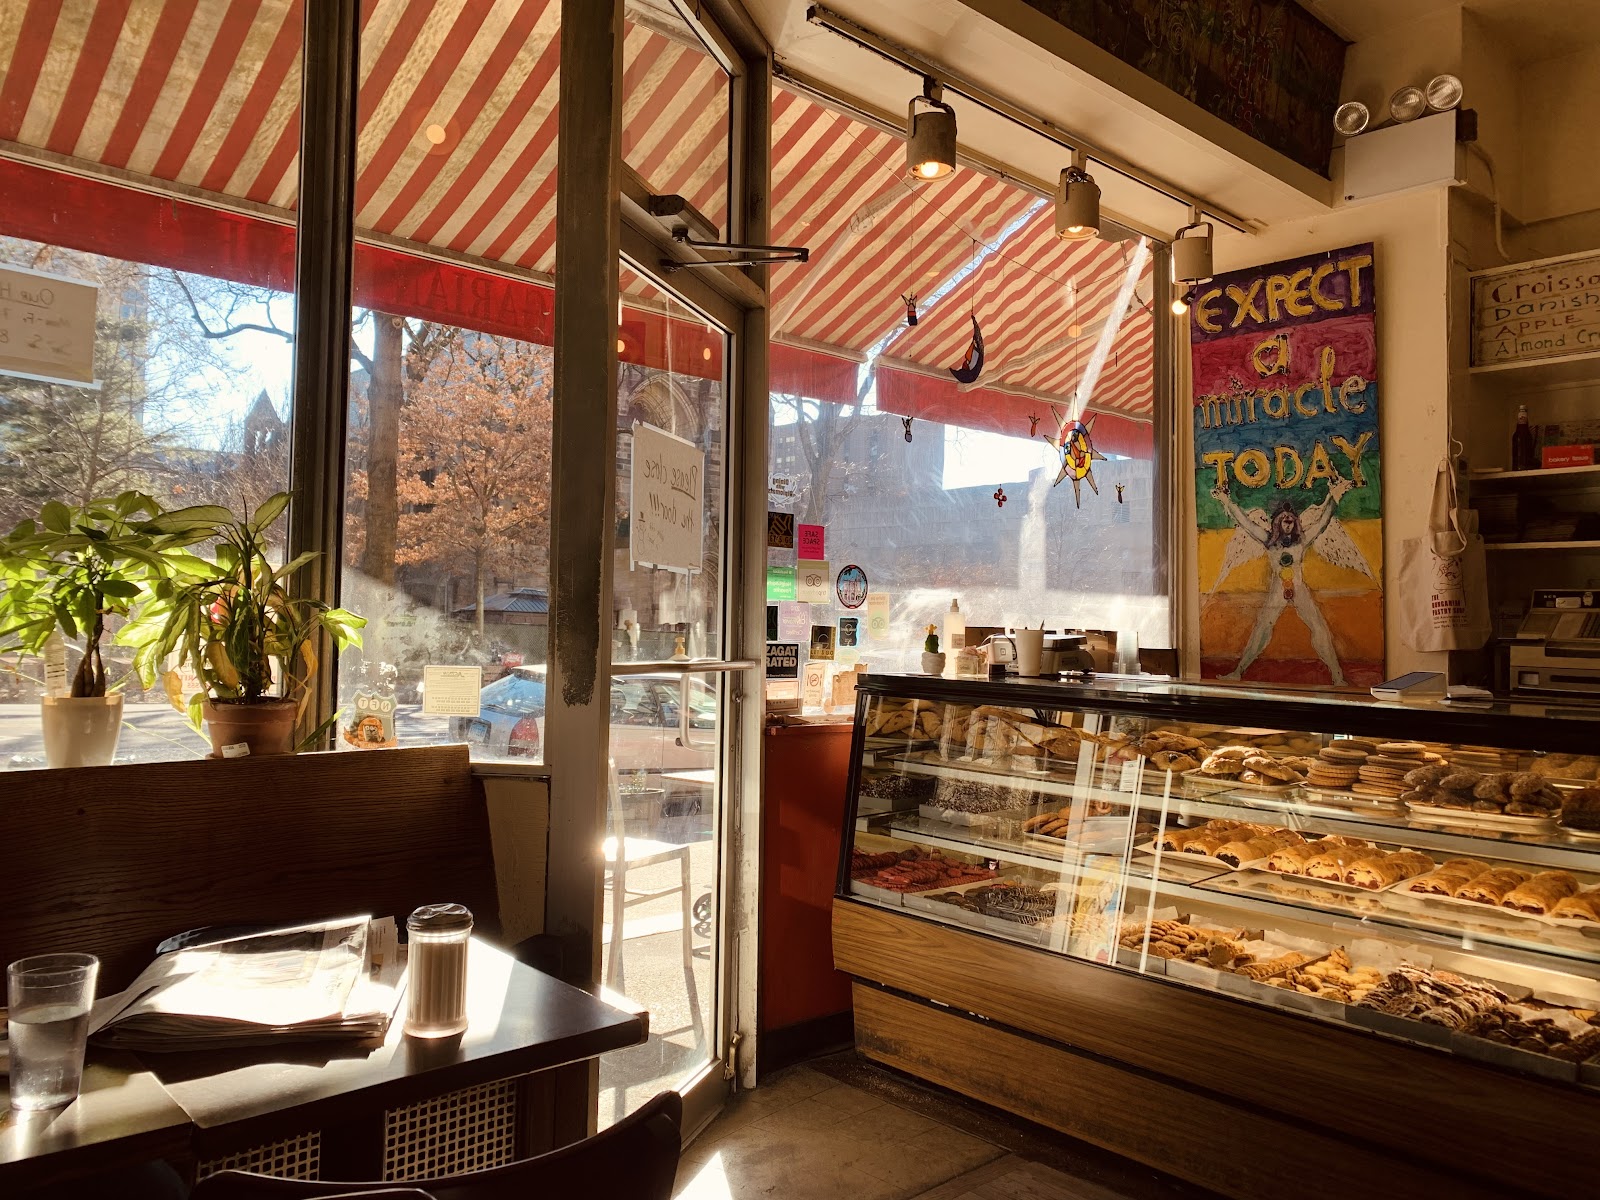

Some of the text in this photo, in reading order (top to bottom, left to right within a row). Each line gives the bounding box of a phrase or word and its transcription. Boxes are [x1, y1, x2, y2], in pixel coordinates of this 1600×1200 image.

[1195, 255, 1373, 334] EXPECT
[1495, 313, 1584, 340] APPLE
[1495, 333, 1566, 357] Almond
[1252, 332, 1291, 380] a
[1197, 345, 1368, 430] miracle
[1202, 432, 1376, 491] TODAY
